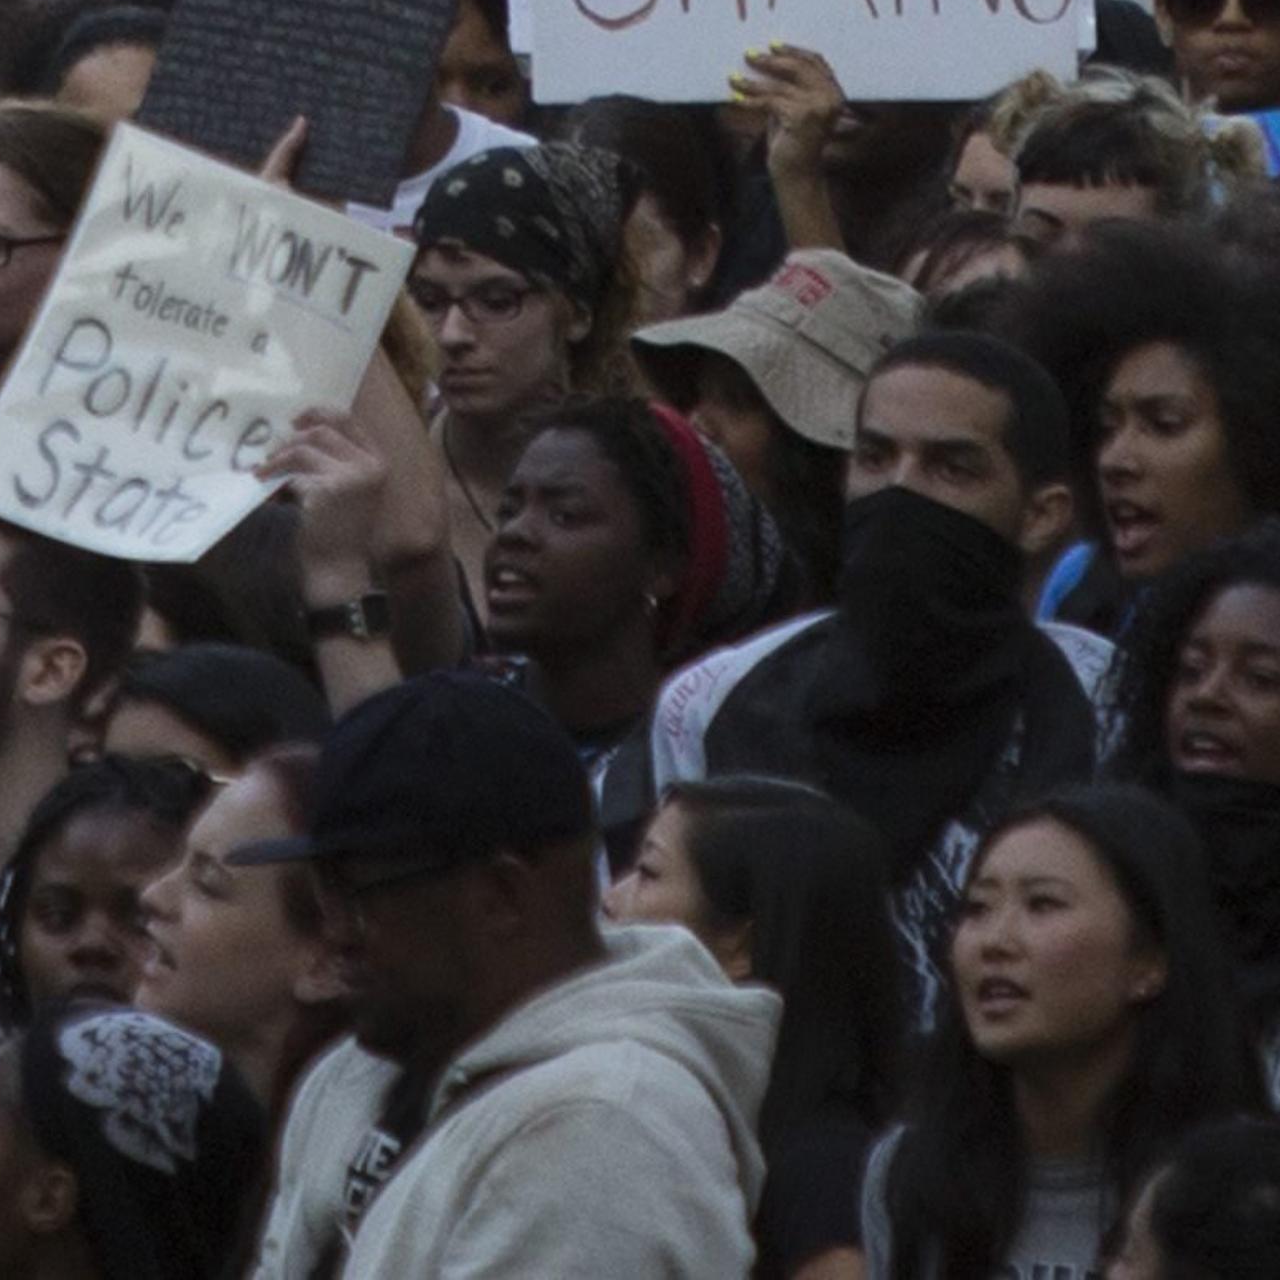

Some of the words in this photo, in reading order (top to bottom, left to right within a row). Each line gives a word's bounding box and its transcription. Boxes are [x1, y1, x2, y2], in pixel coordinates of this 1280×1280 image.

[121, 152, 189, 239] We
[230, 202, 380, 316] WON'T
[115, 260, 231, 339] tolerate
[250, 330, 269, 356] a
[38, 316, 273, 473] Police
[13, 417, 212, 542] State
